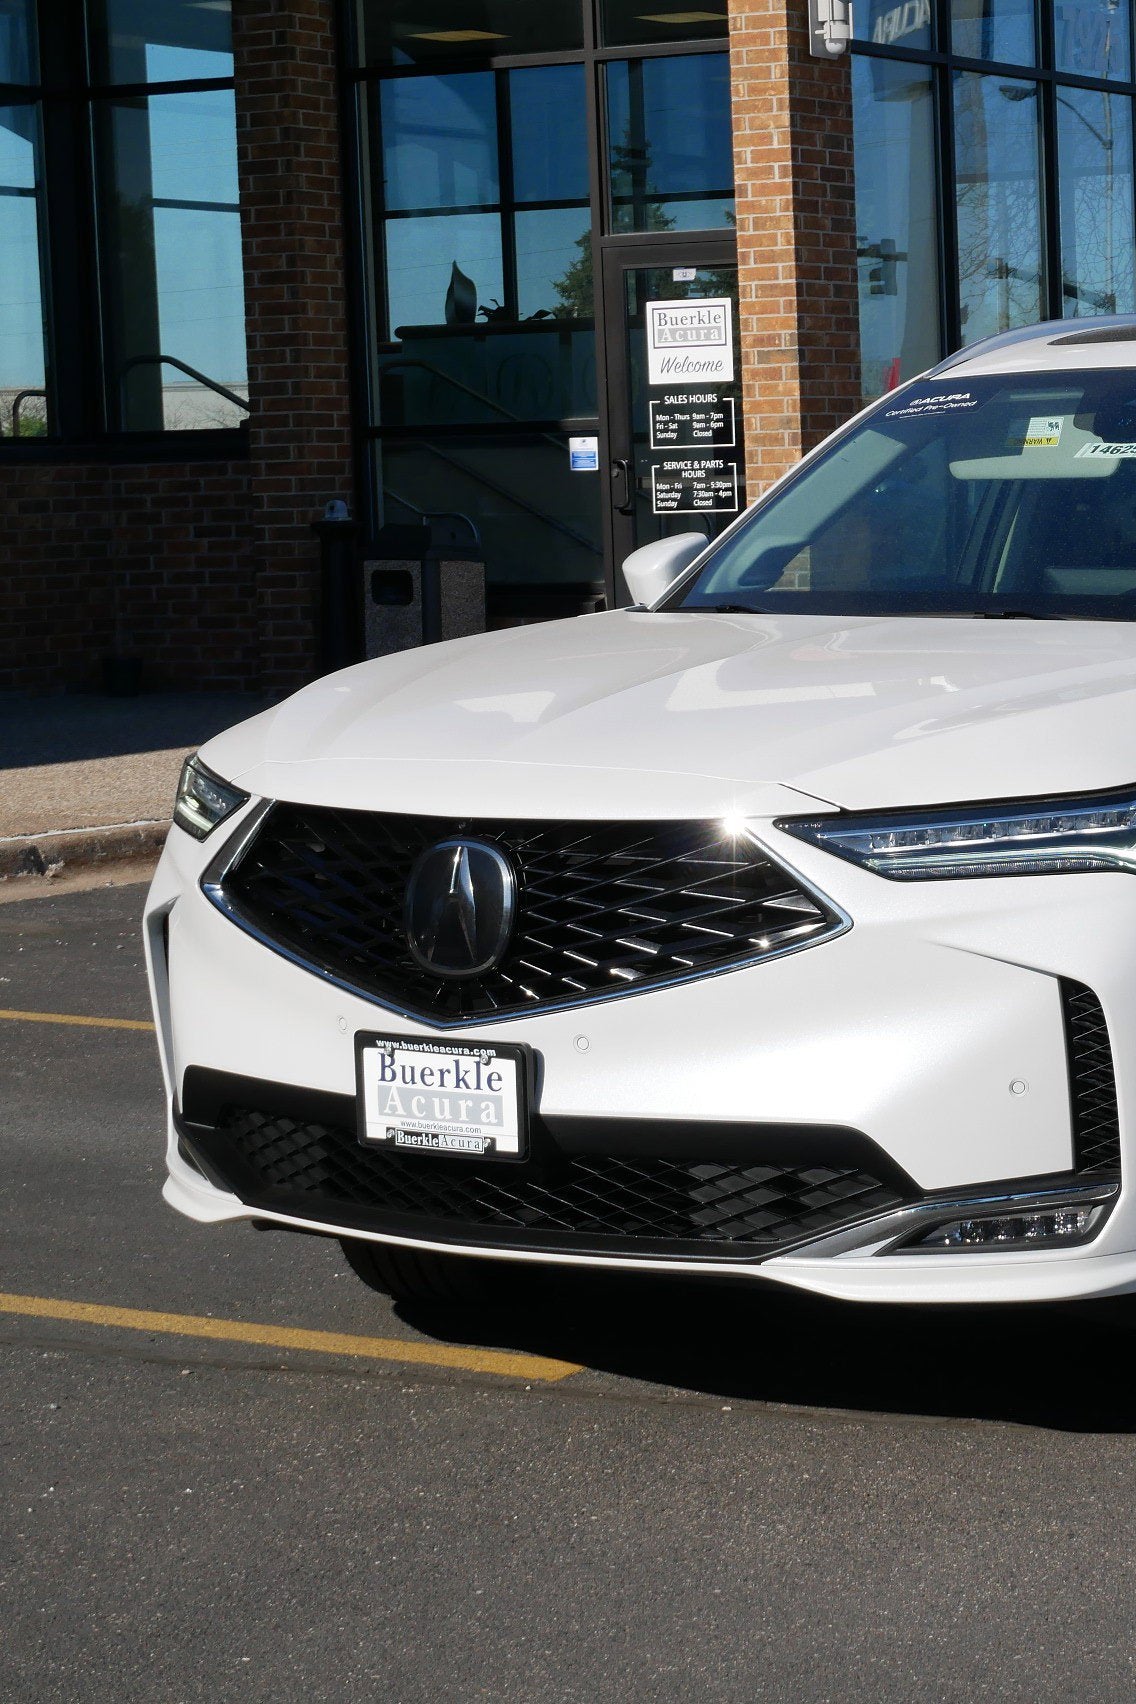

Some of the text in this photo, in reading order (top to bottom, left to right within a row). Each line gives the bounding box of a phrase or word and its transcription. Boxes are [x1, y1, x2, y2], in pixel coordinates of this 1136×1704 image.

[657, 310, 722, 327] Buerkle
[660, 327, 720, 342] Acura
[660, 355, 724, 374] Welcome
[664, 393, 718, 404] SALES HOURS
[710, 412, 724, 421] 7pm
[692, 421, 706, 429] 9am
[710, 421, 724, 429] 6pm
[656, 431, 678, 440] Sunday
[663, 460, 724, 470] SERVICE & PARTS
[682, 470, 706, 478] HOURS
[710, 481, 733, 490] 5:30pm
[656, 491, 682, 499] Saturday
[718, 490, 733, 498] 4pm
[656, 500, 678, 508] Sunday
[375, 1039, 497, 1057] www.buerkleacura.com
[377, 1052, 503, 1092] Buerkle
[383, 1086, 499, 1124] Acura
[400, 1120, 482, 1134] www.buerkleacura.com
